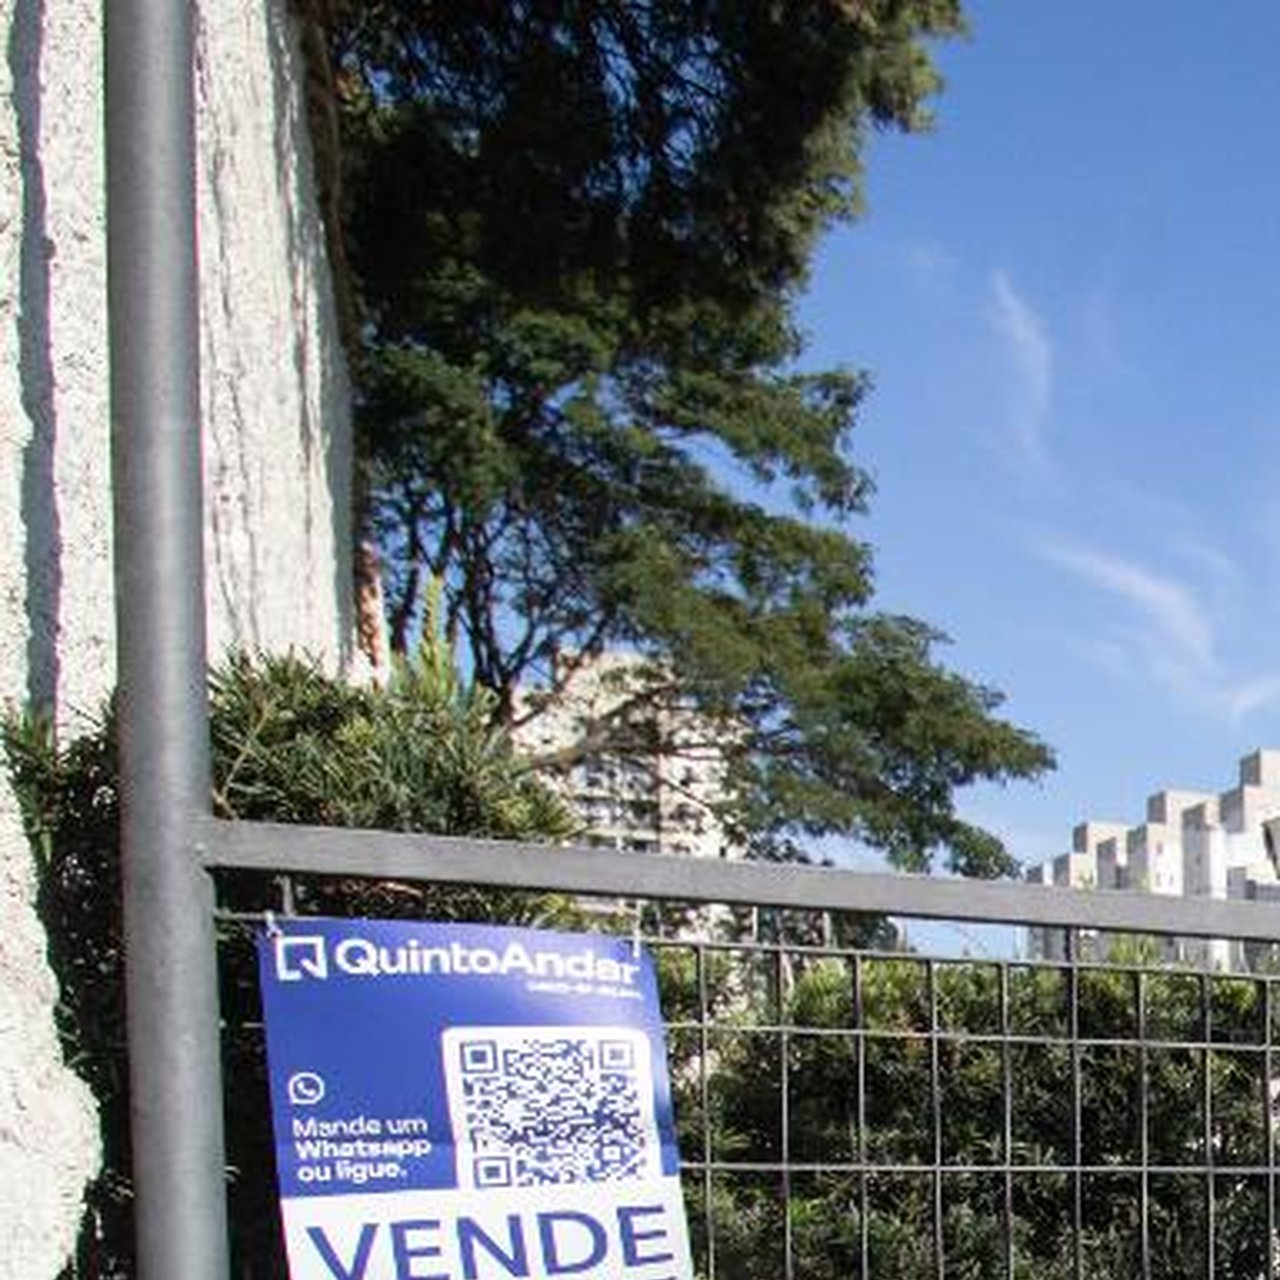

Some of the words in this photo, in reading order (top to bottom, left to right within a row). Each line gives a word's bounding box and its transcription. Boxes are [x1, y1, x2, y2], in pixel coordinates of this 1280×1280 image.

[335, 938, 642, 984] QuintoAndar
[292, 1115, 382, 1138] Mande
[385, 1117, 429, 1135] um
[294, 1139, 432, 1160] Whatsapp
[297, 1165, 331, 1182] ou
[335, 1159, 408, 1184] ligue.
